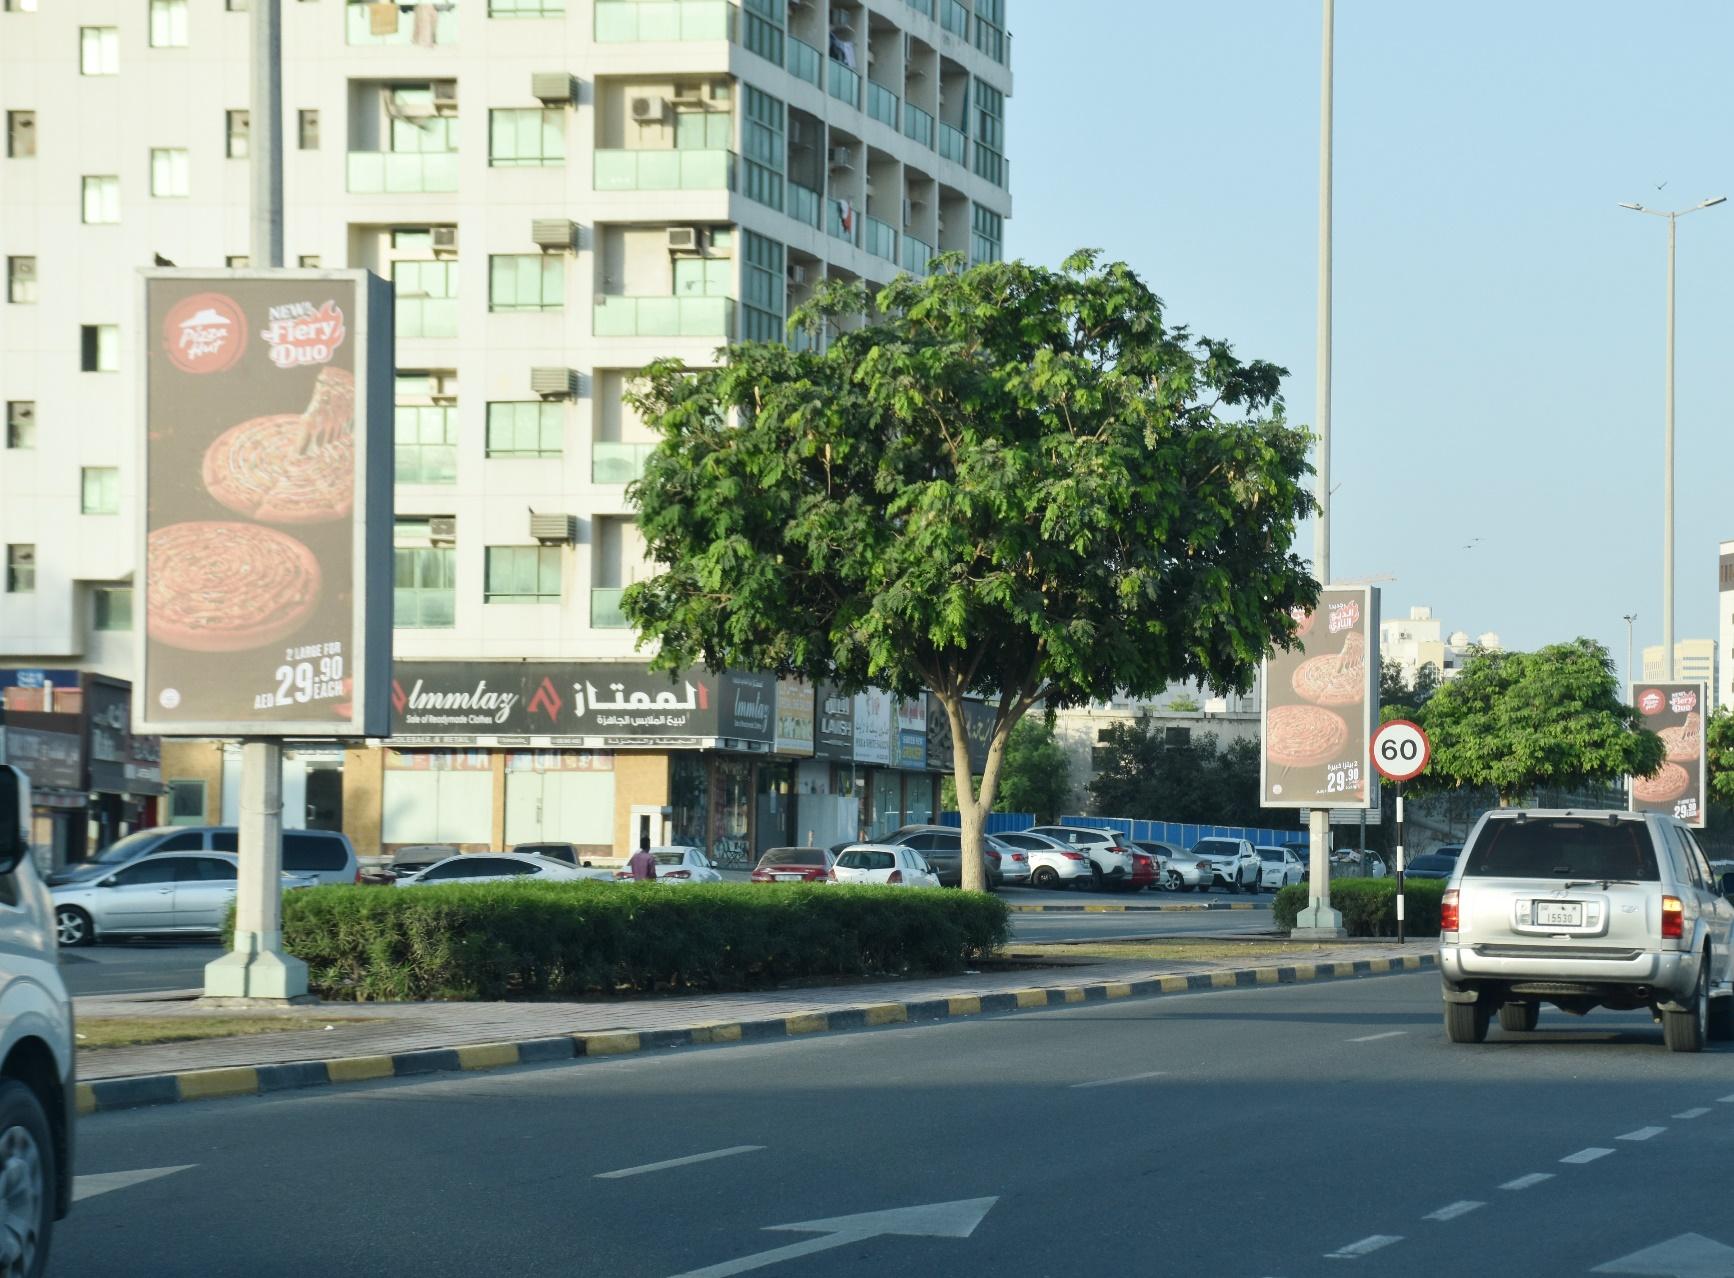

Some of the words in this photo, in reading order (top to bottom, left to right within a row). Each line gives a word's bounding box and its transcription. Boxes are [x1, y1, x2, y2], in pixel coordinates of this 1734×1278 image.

[179, 326, 229, 348] Pizza
[269, 321, 336, 343] Fiery
[187, 340, 224, 360] Hut
[271, 343, 329, 367] Duo
[323, 641, 342, 655] FOR
[313, 680, 343, 699] EACH
[573, 680, 709, 717] الممتاز
[1382, 739, 1417, 761] 60
[1547, 913, 1573, 923] 15530
